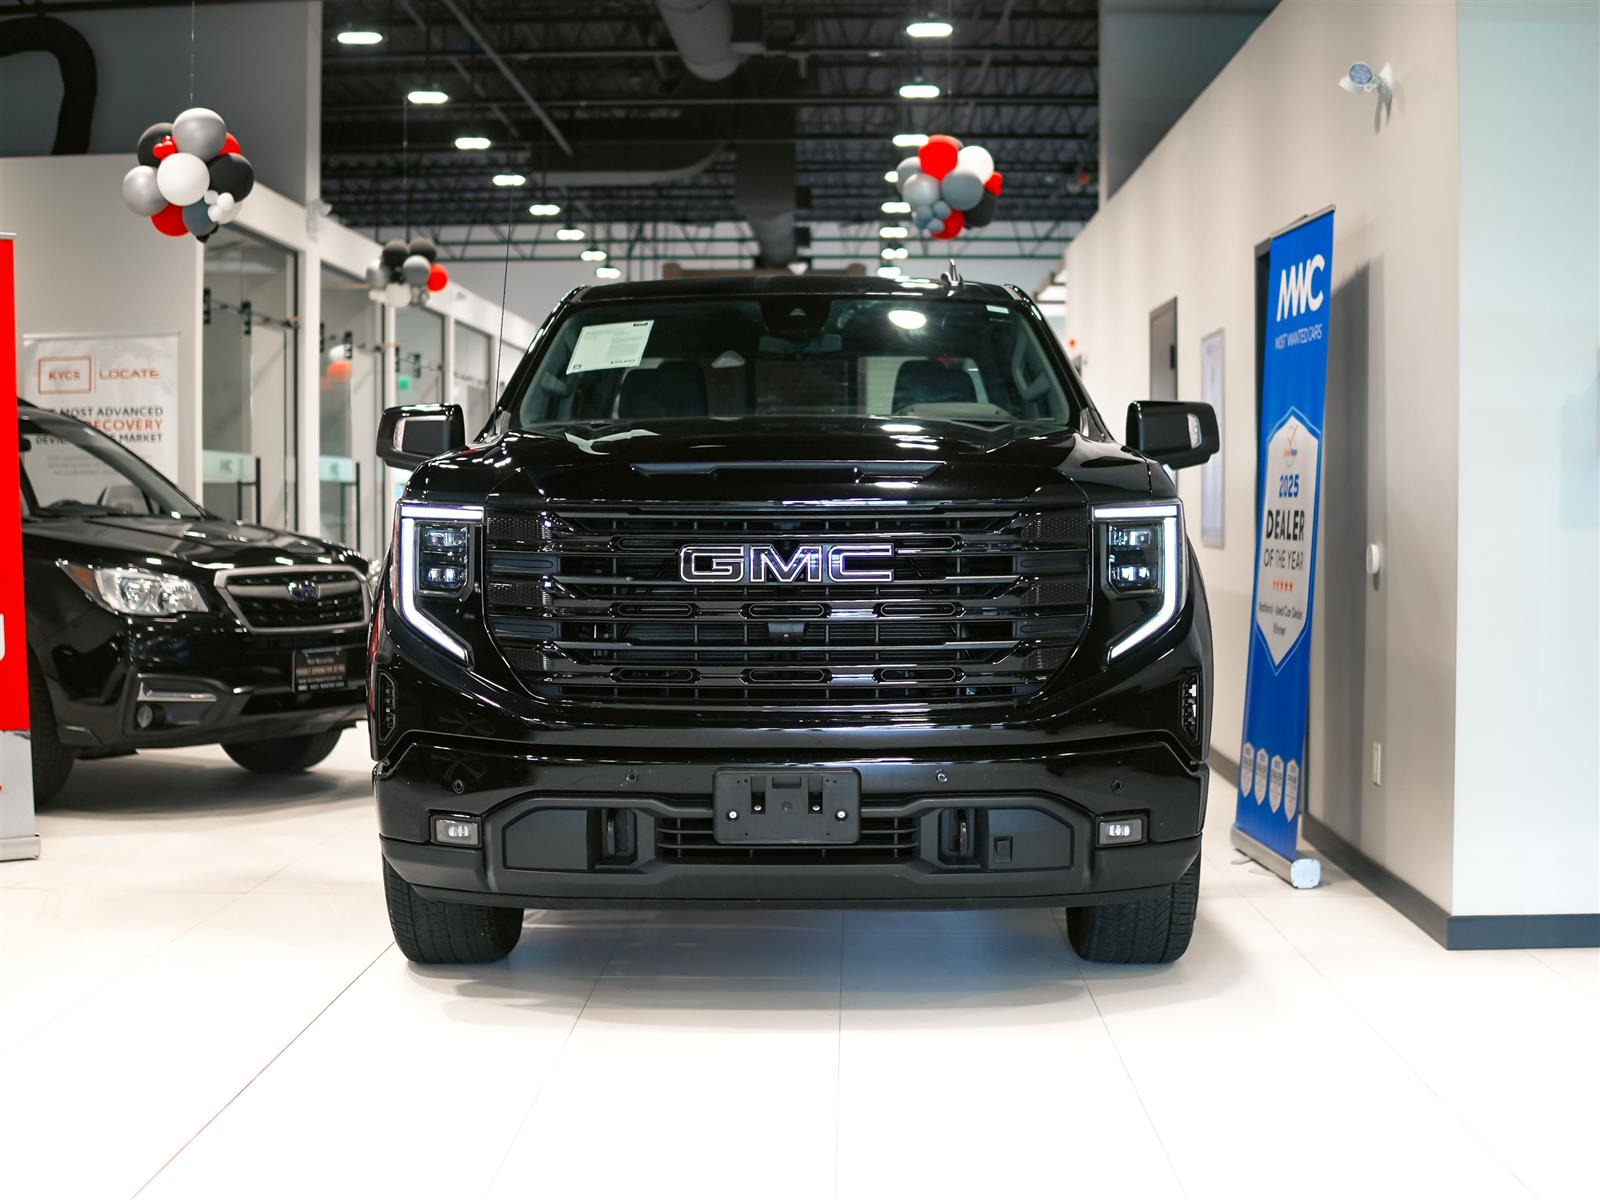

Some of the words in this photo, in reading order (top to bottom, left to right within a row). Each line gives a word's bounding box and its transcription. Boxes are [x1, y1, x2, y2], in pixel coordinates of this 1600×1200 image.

[99, 367, 161, 380] LOCATE
[60, 406, 94, 418] MOST
[97, 406, 164, 417] ADVANCED
[36, 434, 65, 445] DEVI
[119, 433, 162, 443] MARKET
[1279, 474, 1300, 498] 2025
[1266, 509, 1306, 542] DEALER
[679, 543, 894, 584] GMC
[1263, 547, 1275, 568] OF
[1286, 549, 1304, 573] YEAR
